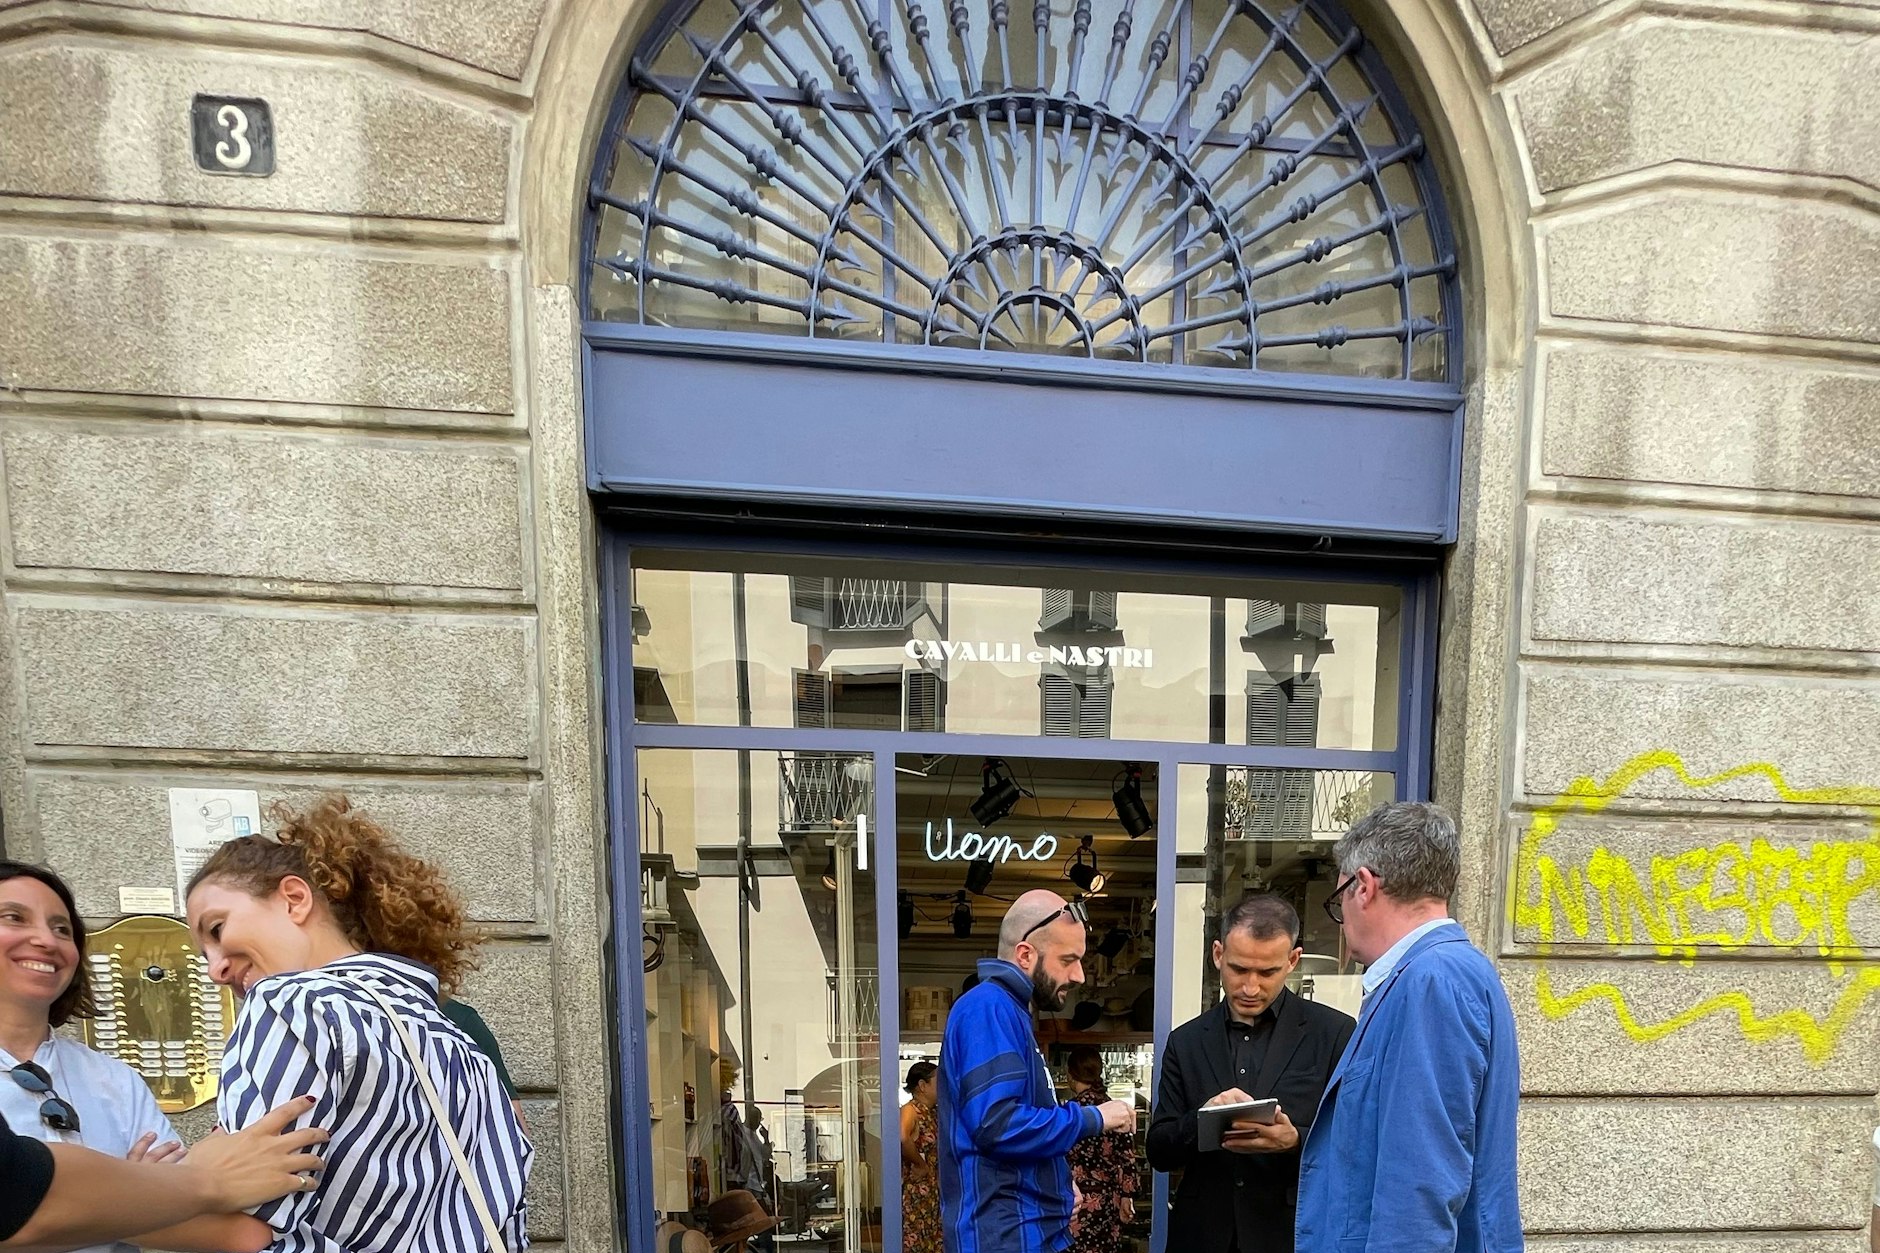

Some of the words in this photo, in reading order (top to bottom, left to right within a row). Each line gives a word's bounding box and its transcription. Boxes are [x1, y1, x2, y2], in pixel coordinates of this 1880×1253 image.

[215, 104, 252, 169] 3
[904, 638, 1021, 663] CAVALLI
[1026, 649, 1044, 664] e
[1049, 643, 1153, 668] NASTRI
[925, 817, 1058, 864] Uomo
